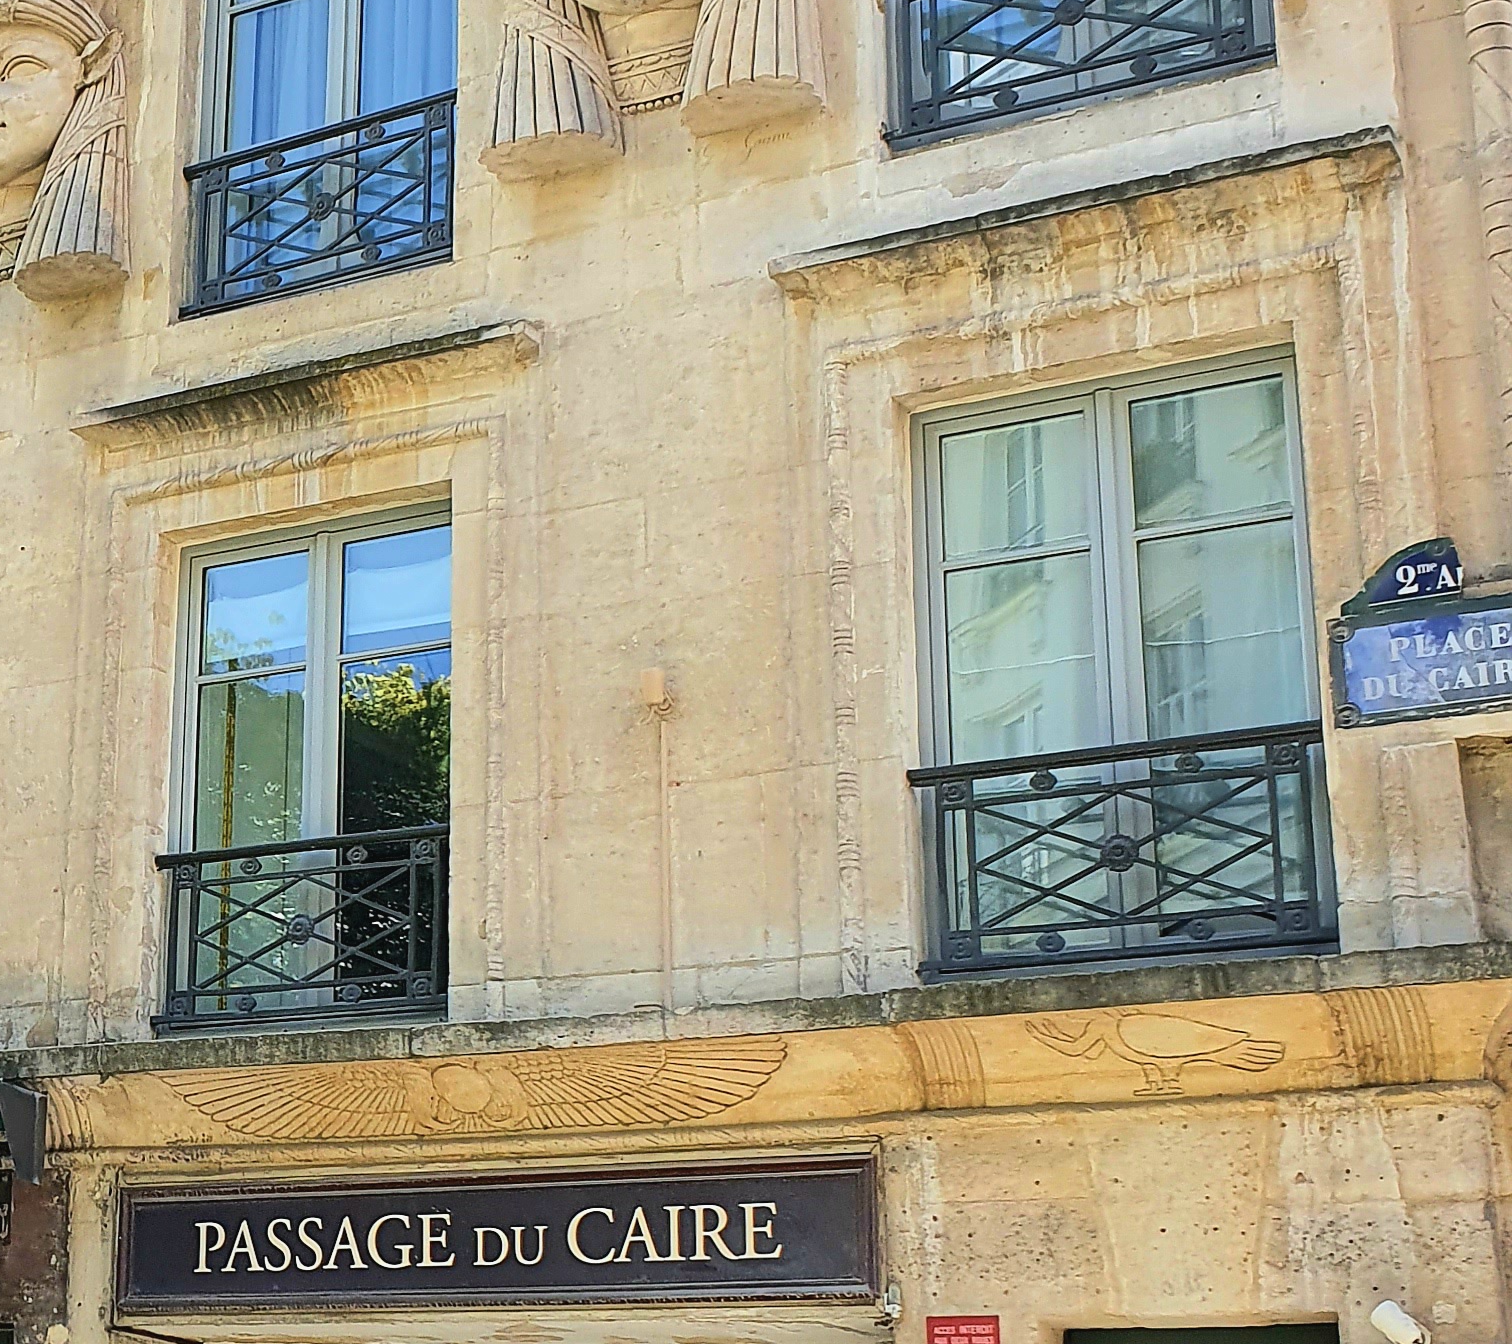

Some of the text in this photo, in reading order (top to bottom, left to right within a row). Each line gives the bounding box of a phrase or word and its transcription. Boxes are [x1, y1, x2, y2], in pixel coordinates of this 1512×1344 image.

[1389, 621, 1512, 662] PLACE
[1362, 674, 1410, 702] DU
[193, 1201, 783, 1274] PASSAGE DU CAIRE
